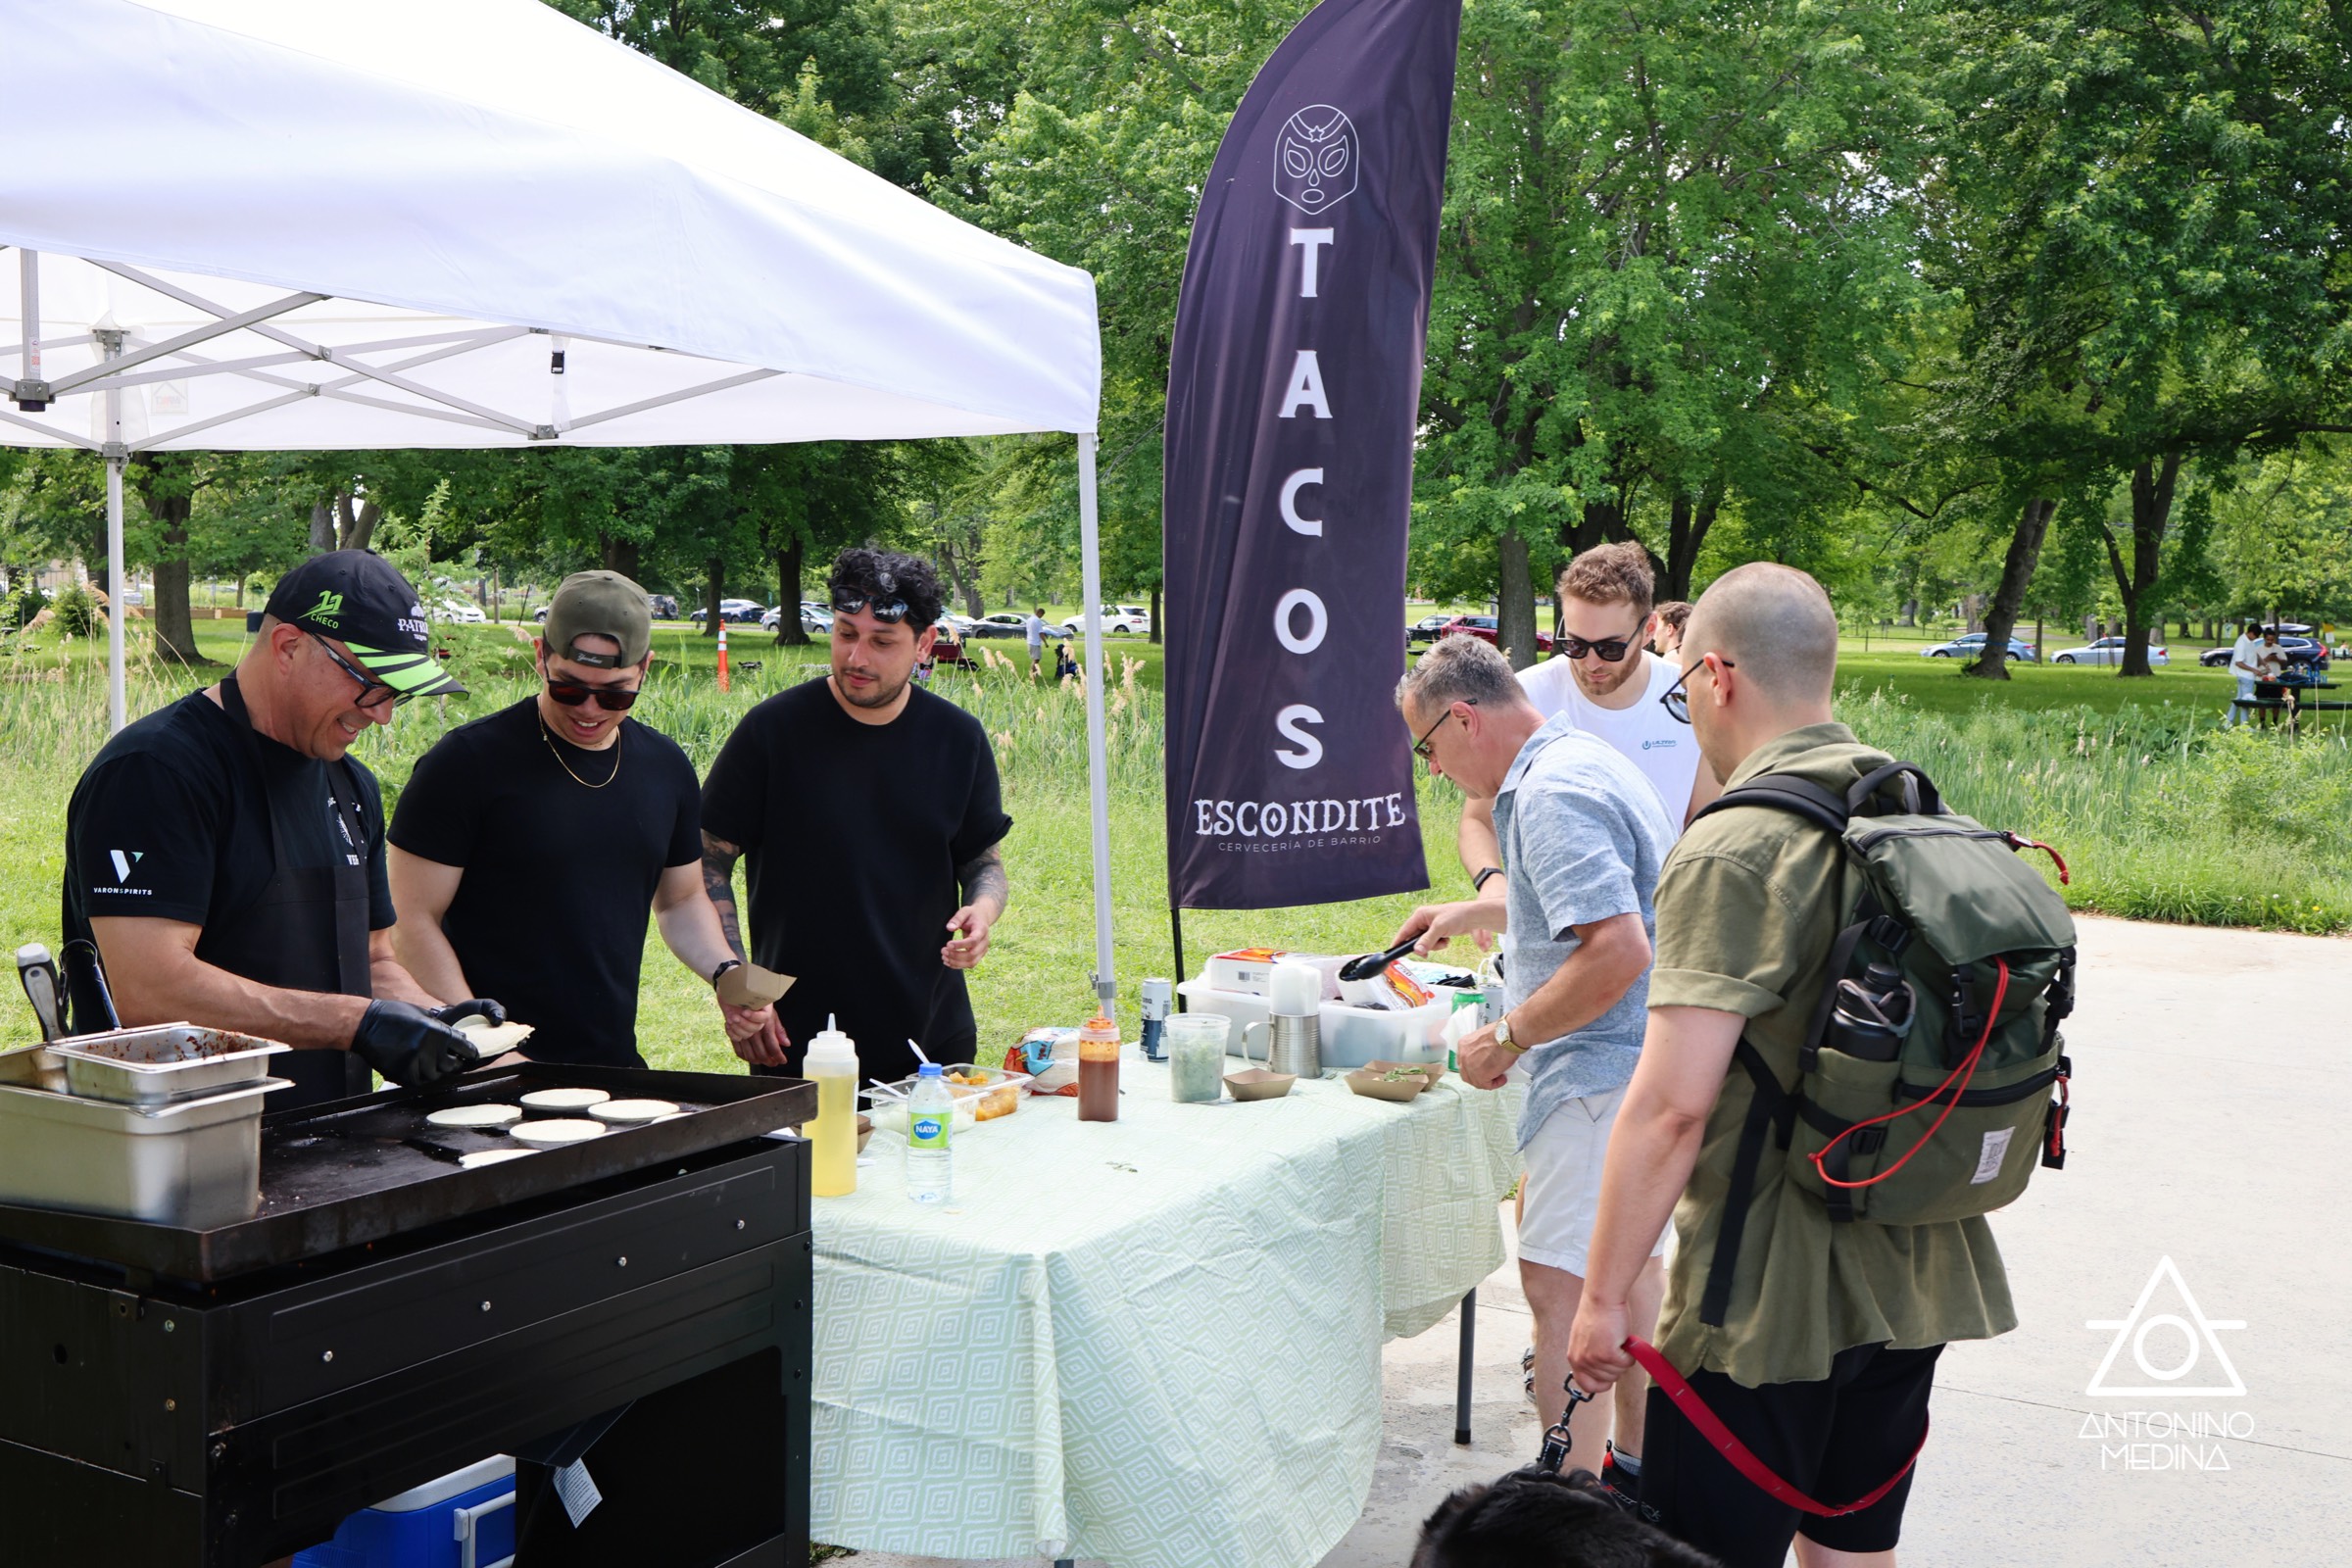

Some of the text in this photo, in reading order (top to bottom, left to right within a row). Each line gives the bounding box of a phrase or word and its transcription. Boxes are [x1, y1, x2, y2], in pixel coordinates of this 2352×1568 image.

[1274, 226, 1334, 770] TACOS
[311, 613, 339, 629] CHECO
[1194, 792, 1405, 837] ESCONDITE
[1218, 835, 1381, 853] CERVECERÍA DE BARRIO
[915, 1125, 939, 1134] NAYA
